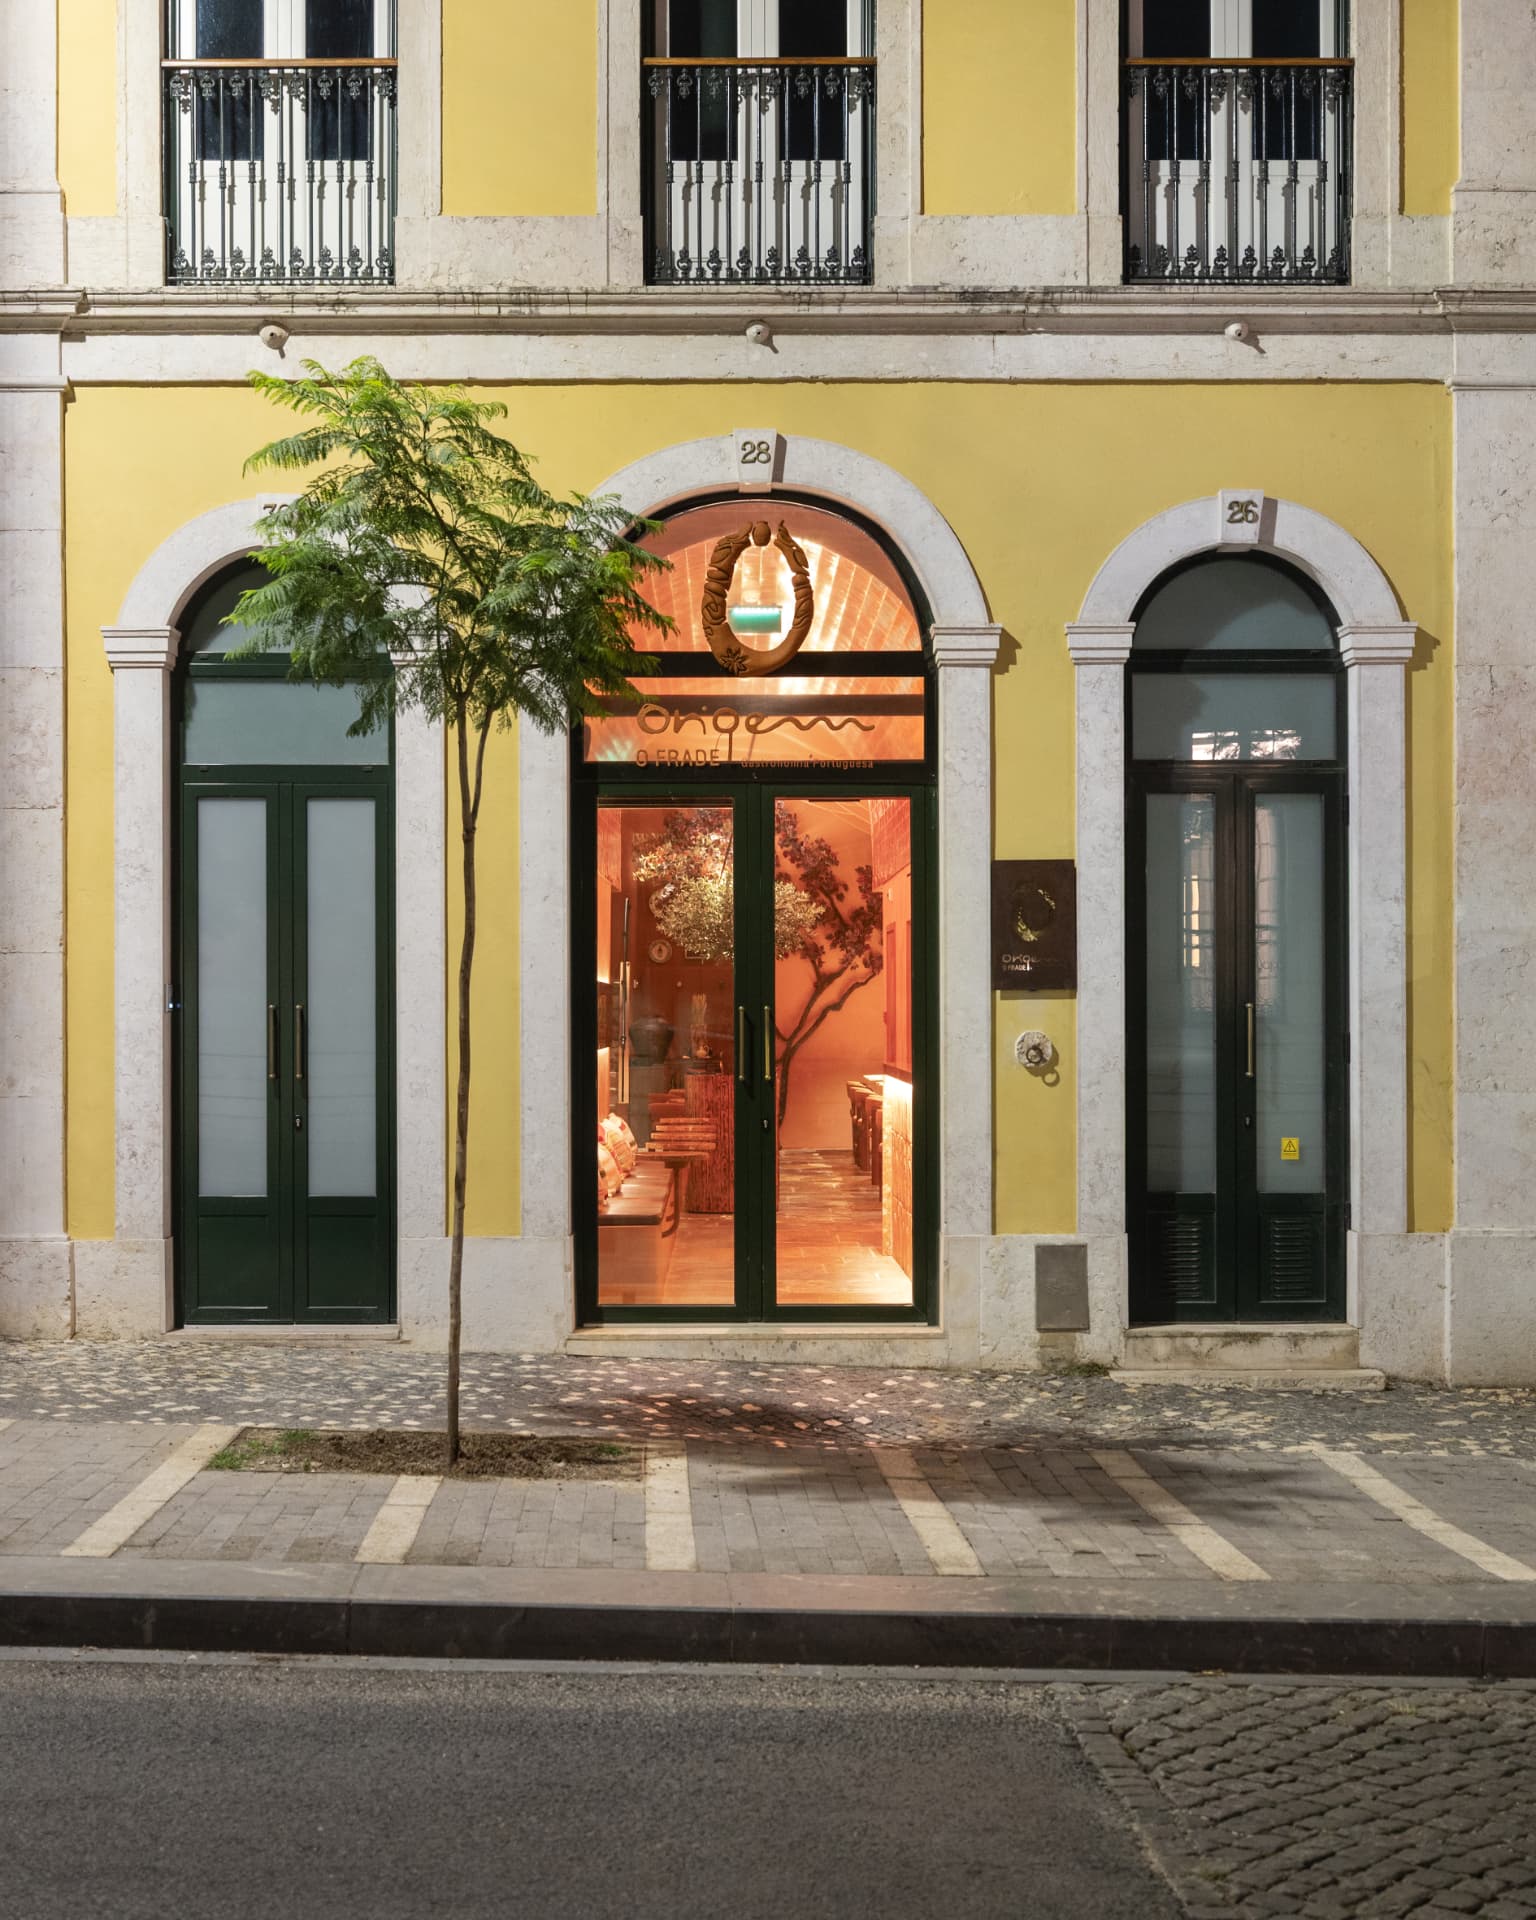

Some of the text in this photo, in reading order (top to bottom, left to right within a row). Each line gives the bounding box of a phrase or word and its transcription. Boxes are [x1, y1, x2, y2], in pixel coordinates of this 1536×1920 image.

[740, 441, 771, 464] 28
[1226, 499, 1259, 524] 26
[635, 749, 720, 768] O FRADE
[812, 758, 874, 770] Portuguesa
